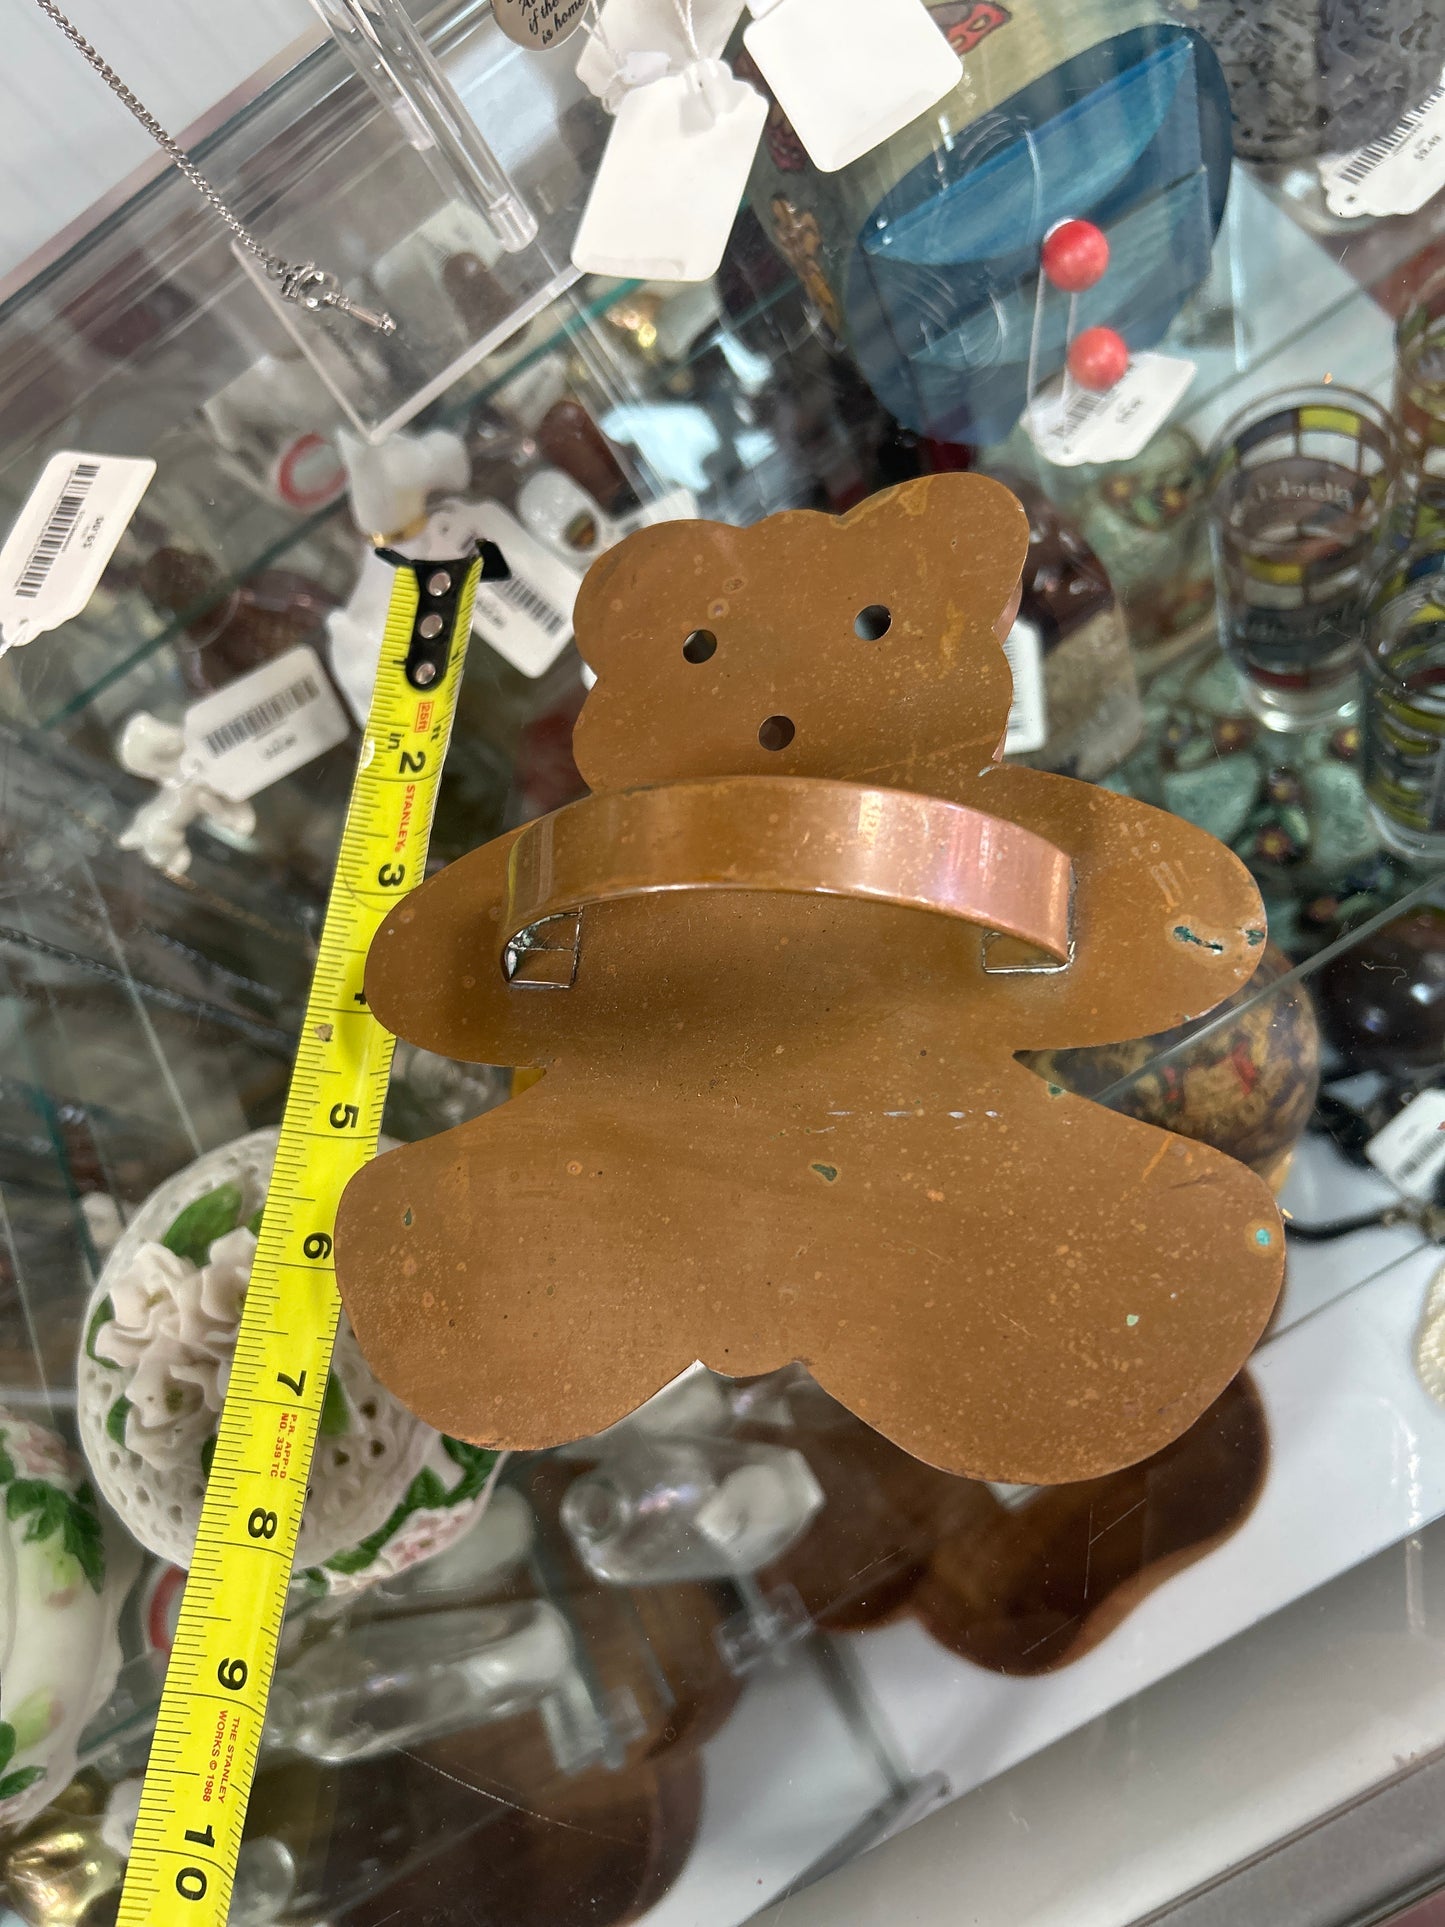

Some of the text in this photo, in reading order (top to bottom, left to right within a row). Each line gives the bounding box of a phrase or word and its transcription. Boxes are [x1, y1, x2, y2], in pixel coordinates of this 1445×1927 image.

[529, 8, 539, 35] if
[542, 0, 584, 44] is home
[388, 733, 403, 750] in
[399, 751, 426, 775] 2
[378, 863, 405, 888] 3
[329, 1102, 359, 1129] 5
[303, 1232, 333, 1260] 6
[276, 1370, 307, 1397] 7
[270, 1412, 289, 1478] NO. 339 TC
[248, 1507, 278, 1540] 8
[217, 1657, 248, 1691] 9
[211, 1709, 229, 1757] WORKS
[217, 1716, 241, 1804] THE STANLEY
[202, 1774, 214, 1803] 1988
